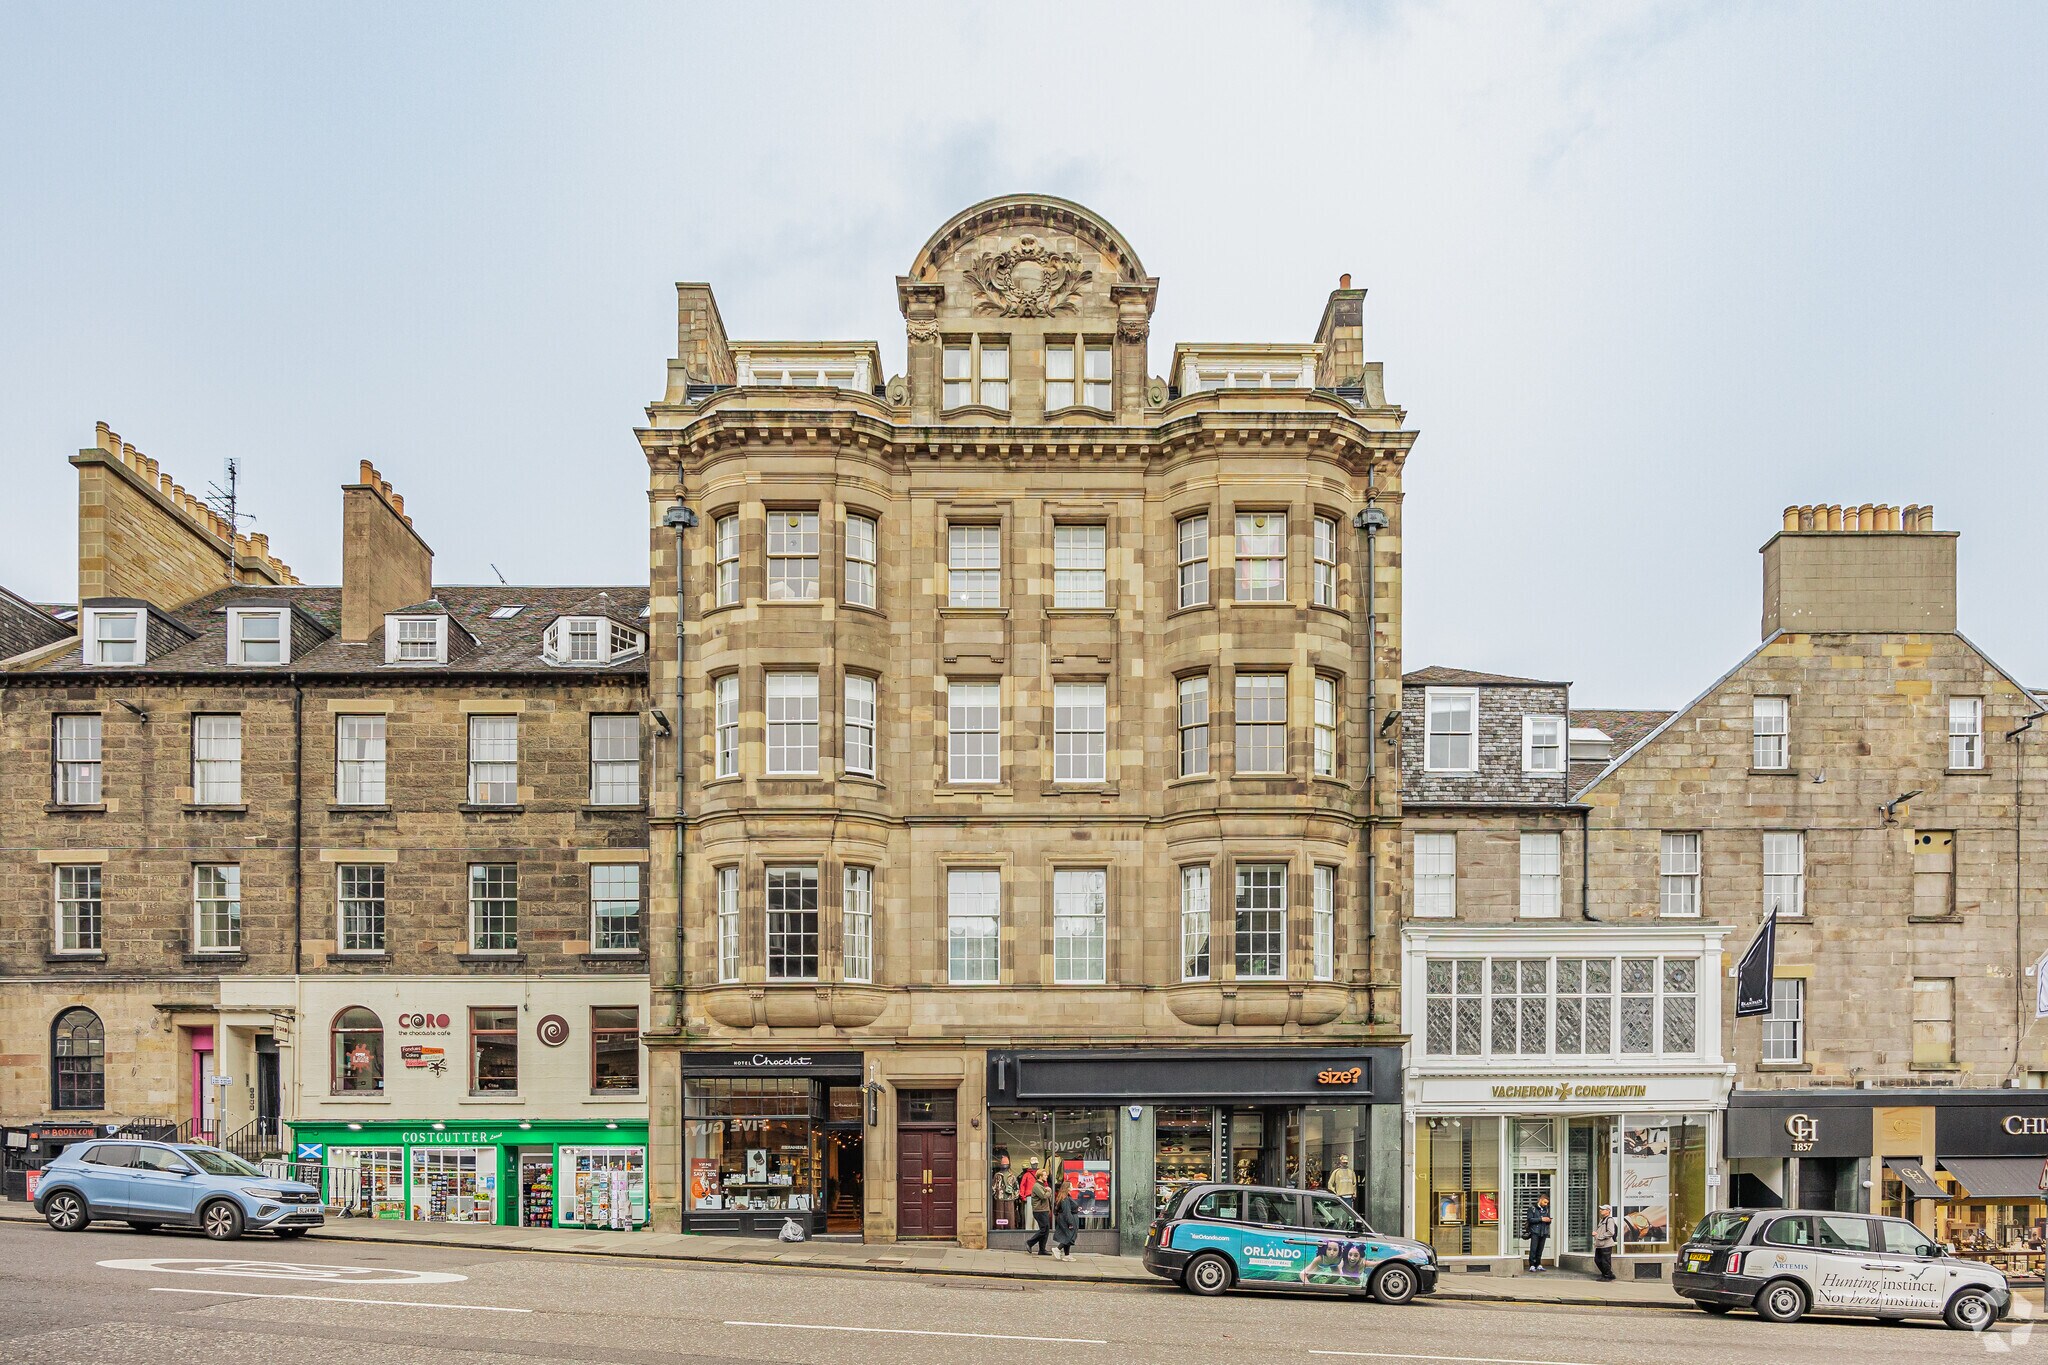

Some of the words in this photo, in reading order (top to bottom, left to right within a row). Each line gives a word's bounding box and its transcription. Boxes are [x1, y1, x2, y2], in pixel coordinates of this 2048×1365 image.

[398, 1013, 451, 1029] CORO
[1317, 1067, 1362, 1084] size?
[1491, 1085, 1554, 1098] VACHERON
[1574, 1085, 1647, 1097] CONSTANTIN
[924, 1103, 931, 1112] 7
[2002, 1115, 2048, 1135] CHI
[78, 1128, 95, 1137] COW
[402, 1132, 488, 1143] COSTCUTTER
[1792, 1142, 1814, 1152] 1857
[1243, 1246, 1302, 1259] ORLANDO
[1772, 1261, 1809, 1270] ARTEMIS
[1822, 1273, 1880, 1293] Hunting
[1882, 1277, 1937, 1292] instinct.
[1818, 1289, 1846, 1304] Not
[1849, 1291, 1880, 1305] herd
[1884, 1294, 1939, 1308] instinct.
